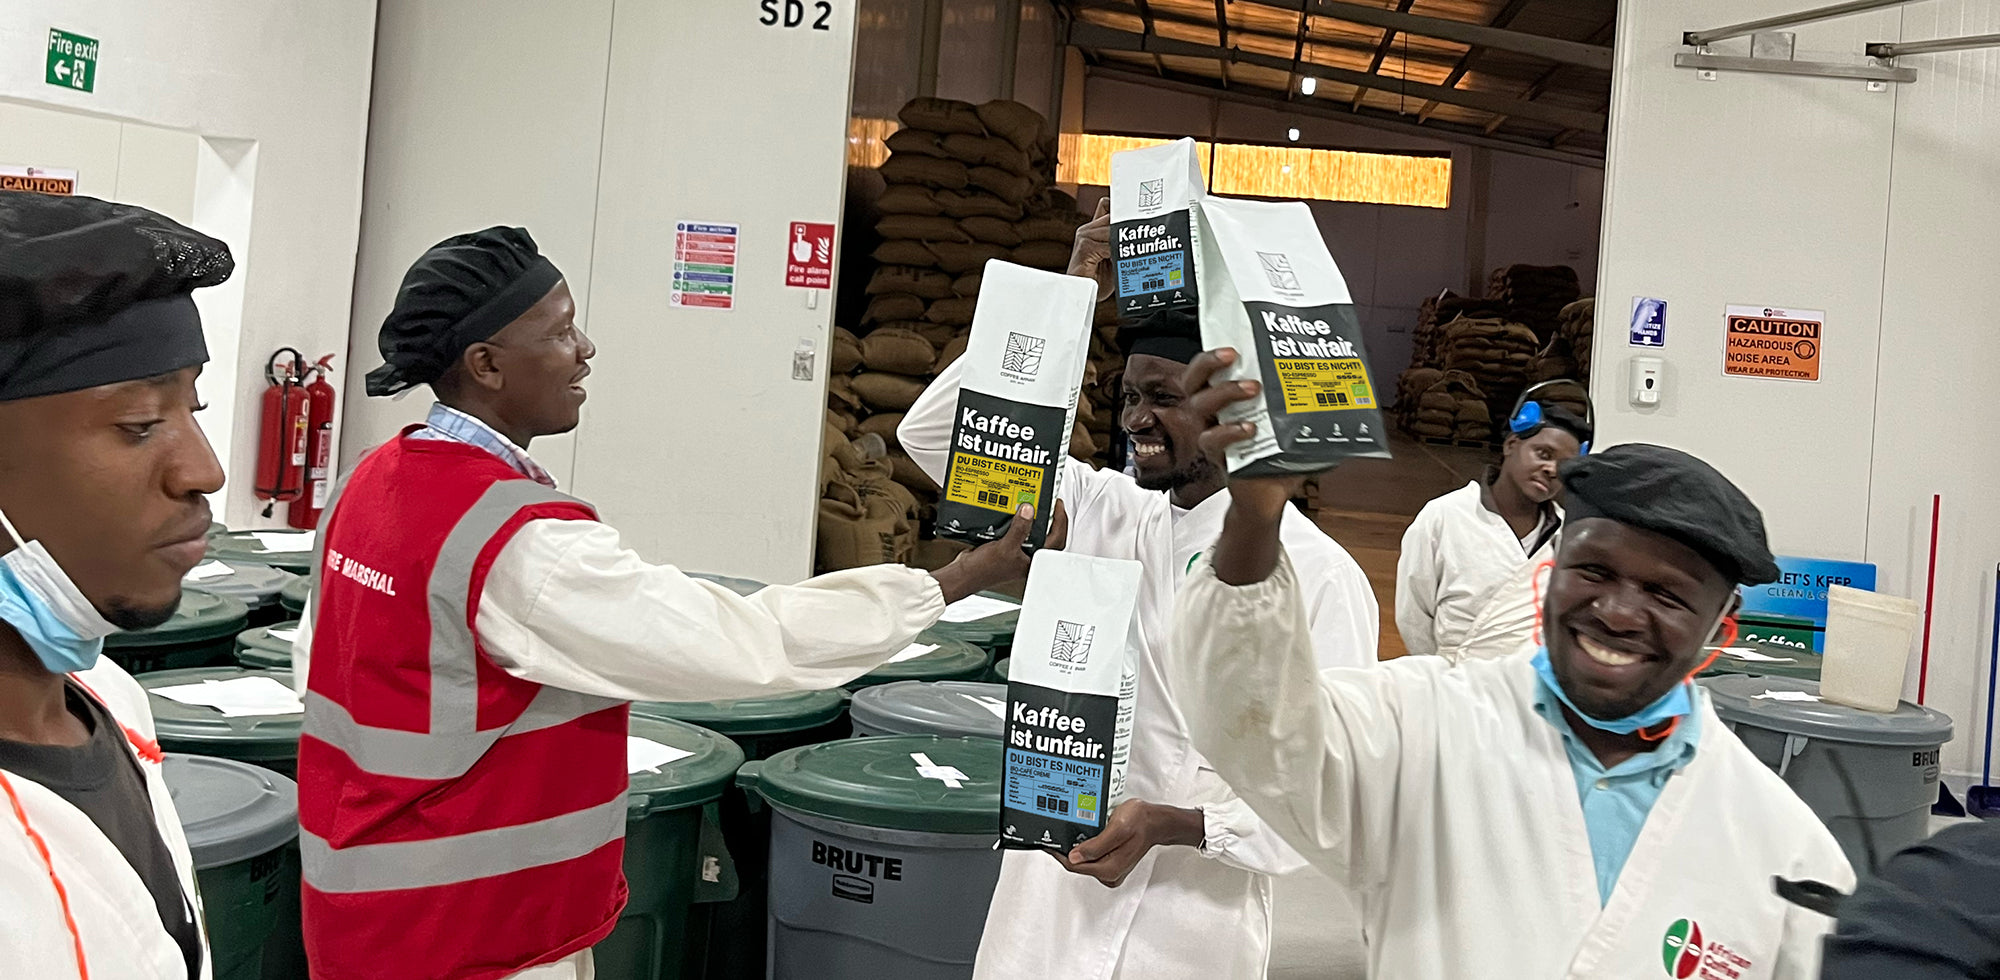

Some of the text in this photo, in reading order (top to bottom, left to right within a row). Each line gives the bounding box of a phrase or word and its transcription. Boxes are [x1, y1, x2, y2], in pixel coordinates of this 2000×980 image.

[759, 0, 832, 30] SD 2
[49, 31, 97, 61] Fire exit
[3, 176, 69, 193] CAUTION
[1118, 224, 1166, 242] Kaffee
[1119, 235, 1182, 258] ist unfair.
[789, 264, 830, 275] Fire alarm
[1120, 261, 1131, 269] DU
[1131, 258, 1148, 267] BIST
[1148, 256, 1158, 265] ES
[789, 275, 827, 285] call point
[1261, 310, 1331, 336] Kaffee
[1734, 319, 1815, 337] CAUTION
[1269, 334, 1359, 358] ist unfair.
[1728, 337, 1793, 351] HAZARDOUS
[1279, 361, 1363, 371] DU BIST ES NICHT!
[1727, 352, 1791, 366] NOISE AREA
[1727, 365, 1810, 378] WEAR EAR PROTECTION
[961, 406, 1035, 441] Kaffee
[957, 428, 1052, 465] ist unfair.
[957, 455, 1041, 479] DU BIST ES NICHT!
[341, 557, 397, 597] MARSHAL
[1767, 587, 1804, 599] CLEAN
[1807, 590, 1814, 599] &
[1012, 700, 1086, 733] Kaffee
[1010, 724, 1106, 760] ist unfair.
[1010, 752, 1101, 779] DU BIST ES NICHT!
[812, 840, 903, 881] BRUTE
